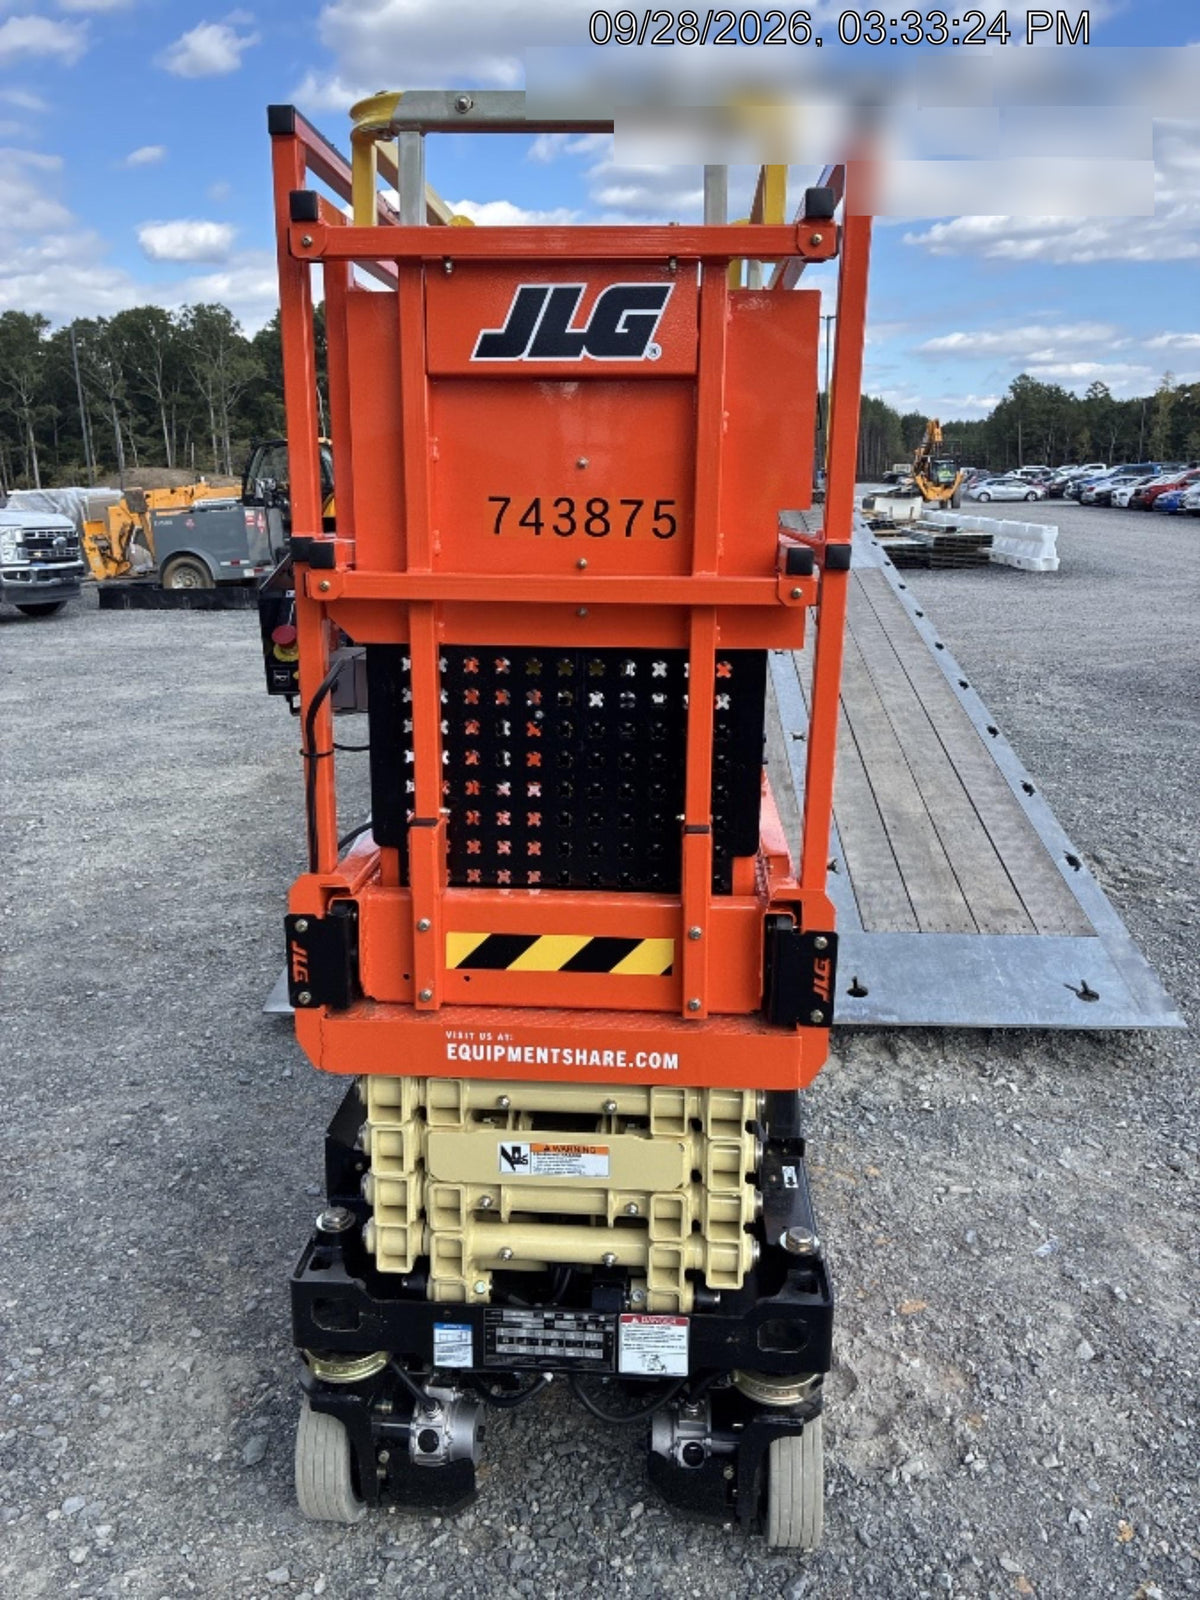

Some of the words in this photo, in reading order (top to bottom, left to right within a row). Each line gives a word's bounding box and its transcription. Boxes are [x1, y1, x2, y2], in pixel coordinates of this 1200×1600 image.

[488, 496, 677, 539] 743875
[291, 940, 309, 983] JLG
[813, 957, 830, 1003] JLG
[446, 1030, 474, 1040] VISIT
[479, 1032, 492, 1041] US
[446, 1042, 679, 1070] EQUIPMENTSHARE.COM
[552, 1144, 596, 1154] WARNING
